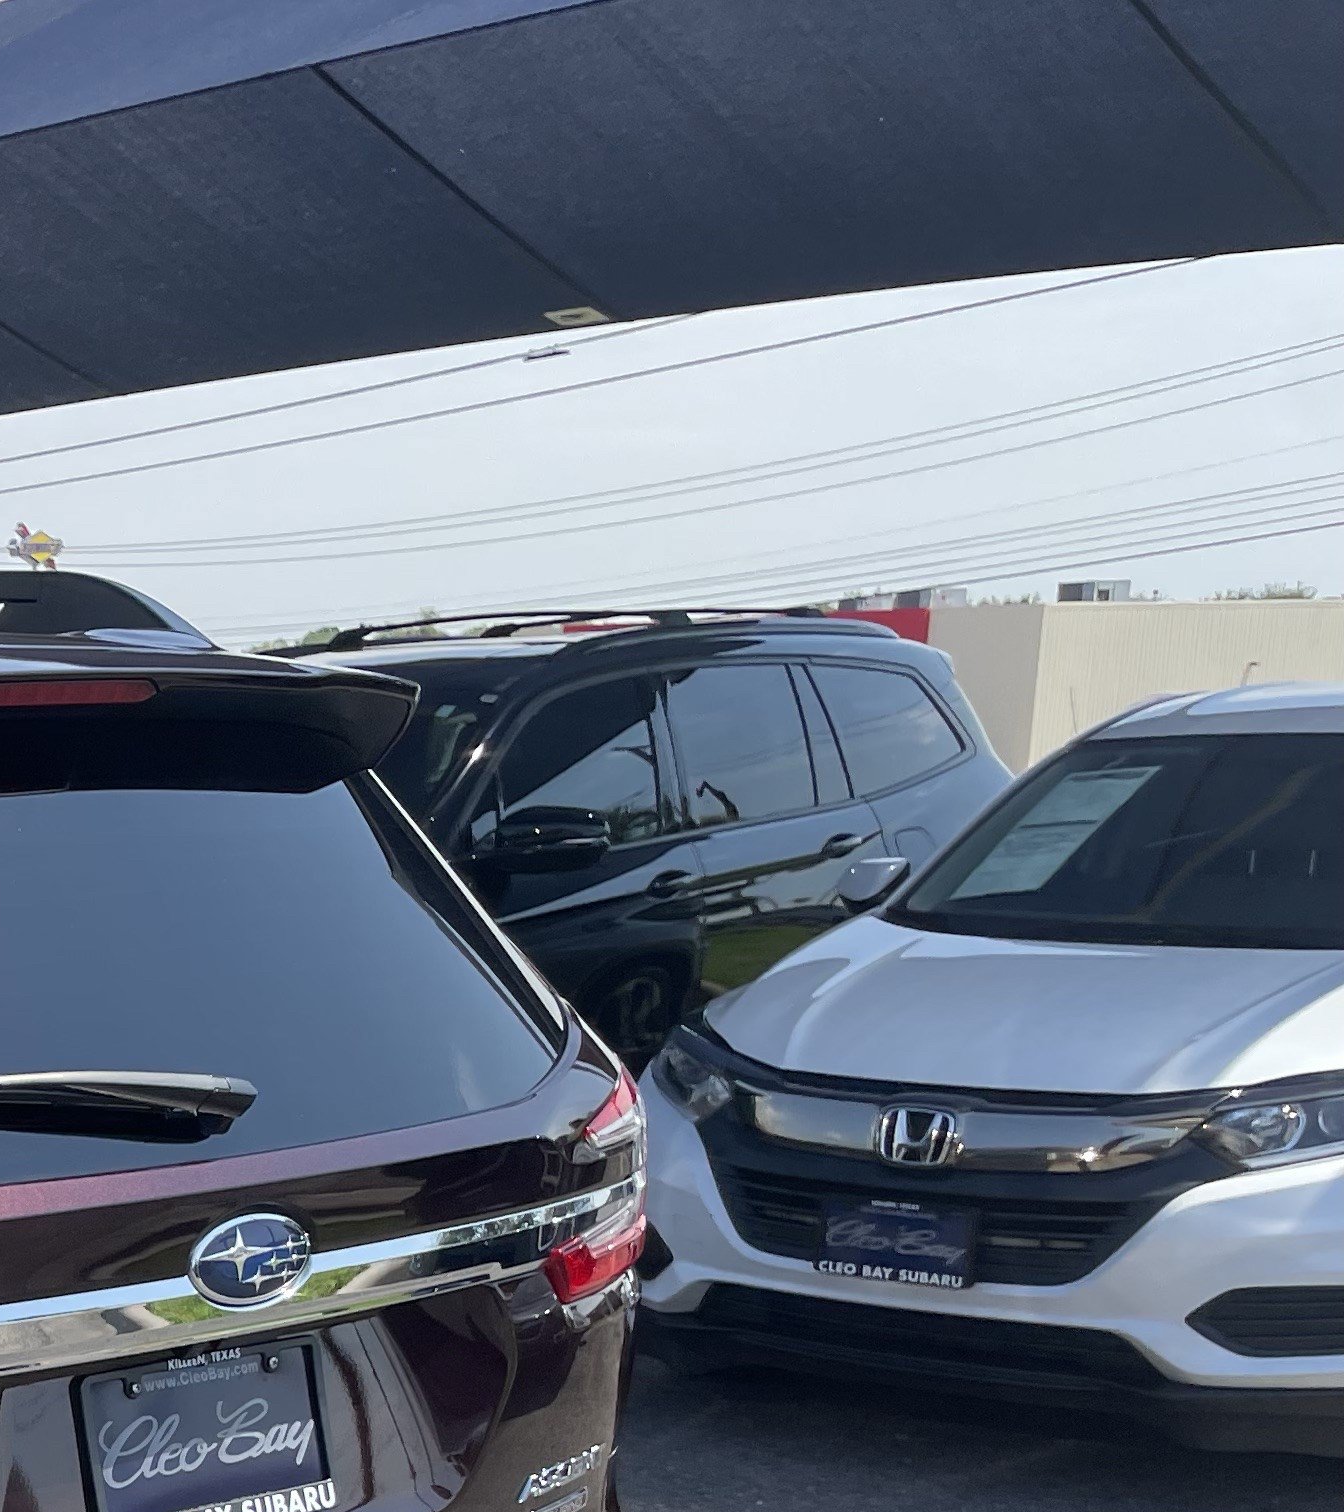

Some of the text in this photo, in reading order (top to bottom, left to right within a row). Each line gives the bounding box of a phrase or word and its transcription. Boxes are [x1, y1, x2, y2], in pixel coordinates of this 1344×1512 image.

[818, 1260, 963, 1288] CLEO BAY SUBARU
[211, 1347, 241, 1362] TEXAS
[144, 1361, 259, 1392] www.CleoBay.com
[99, 1397, 315, 1489] Cleo Bay
